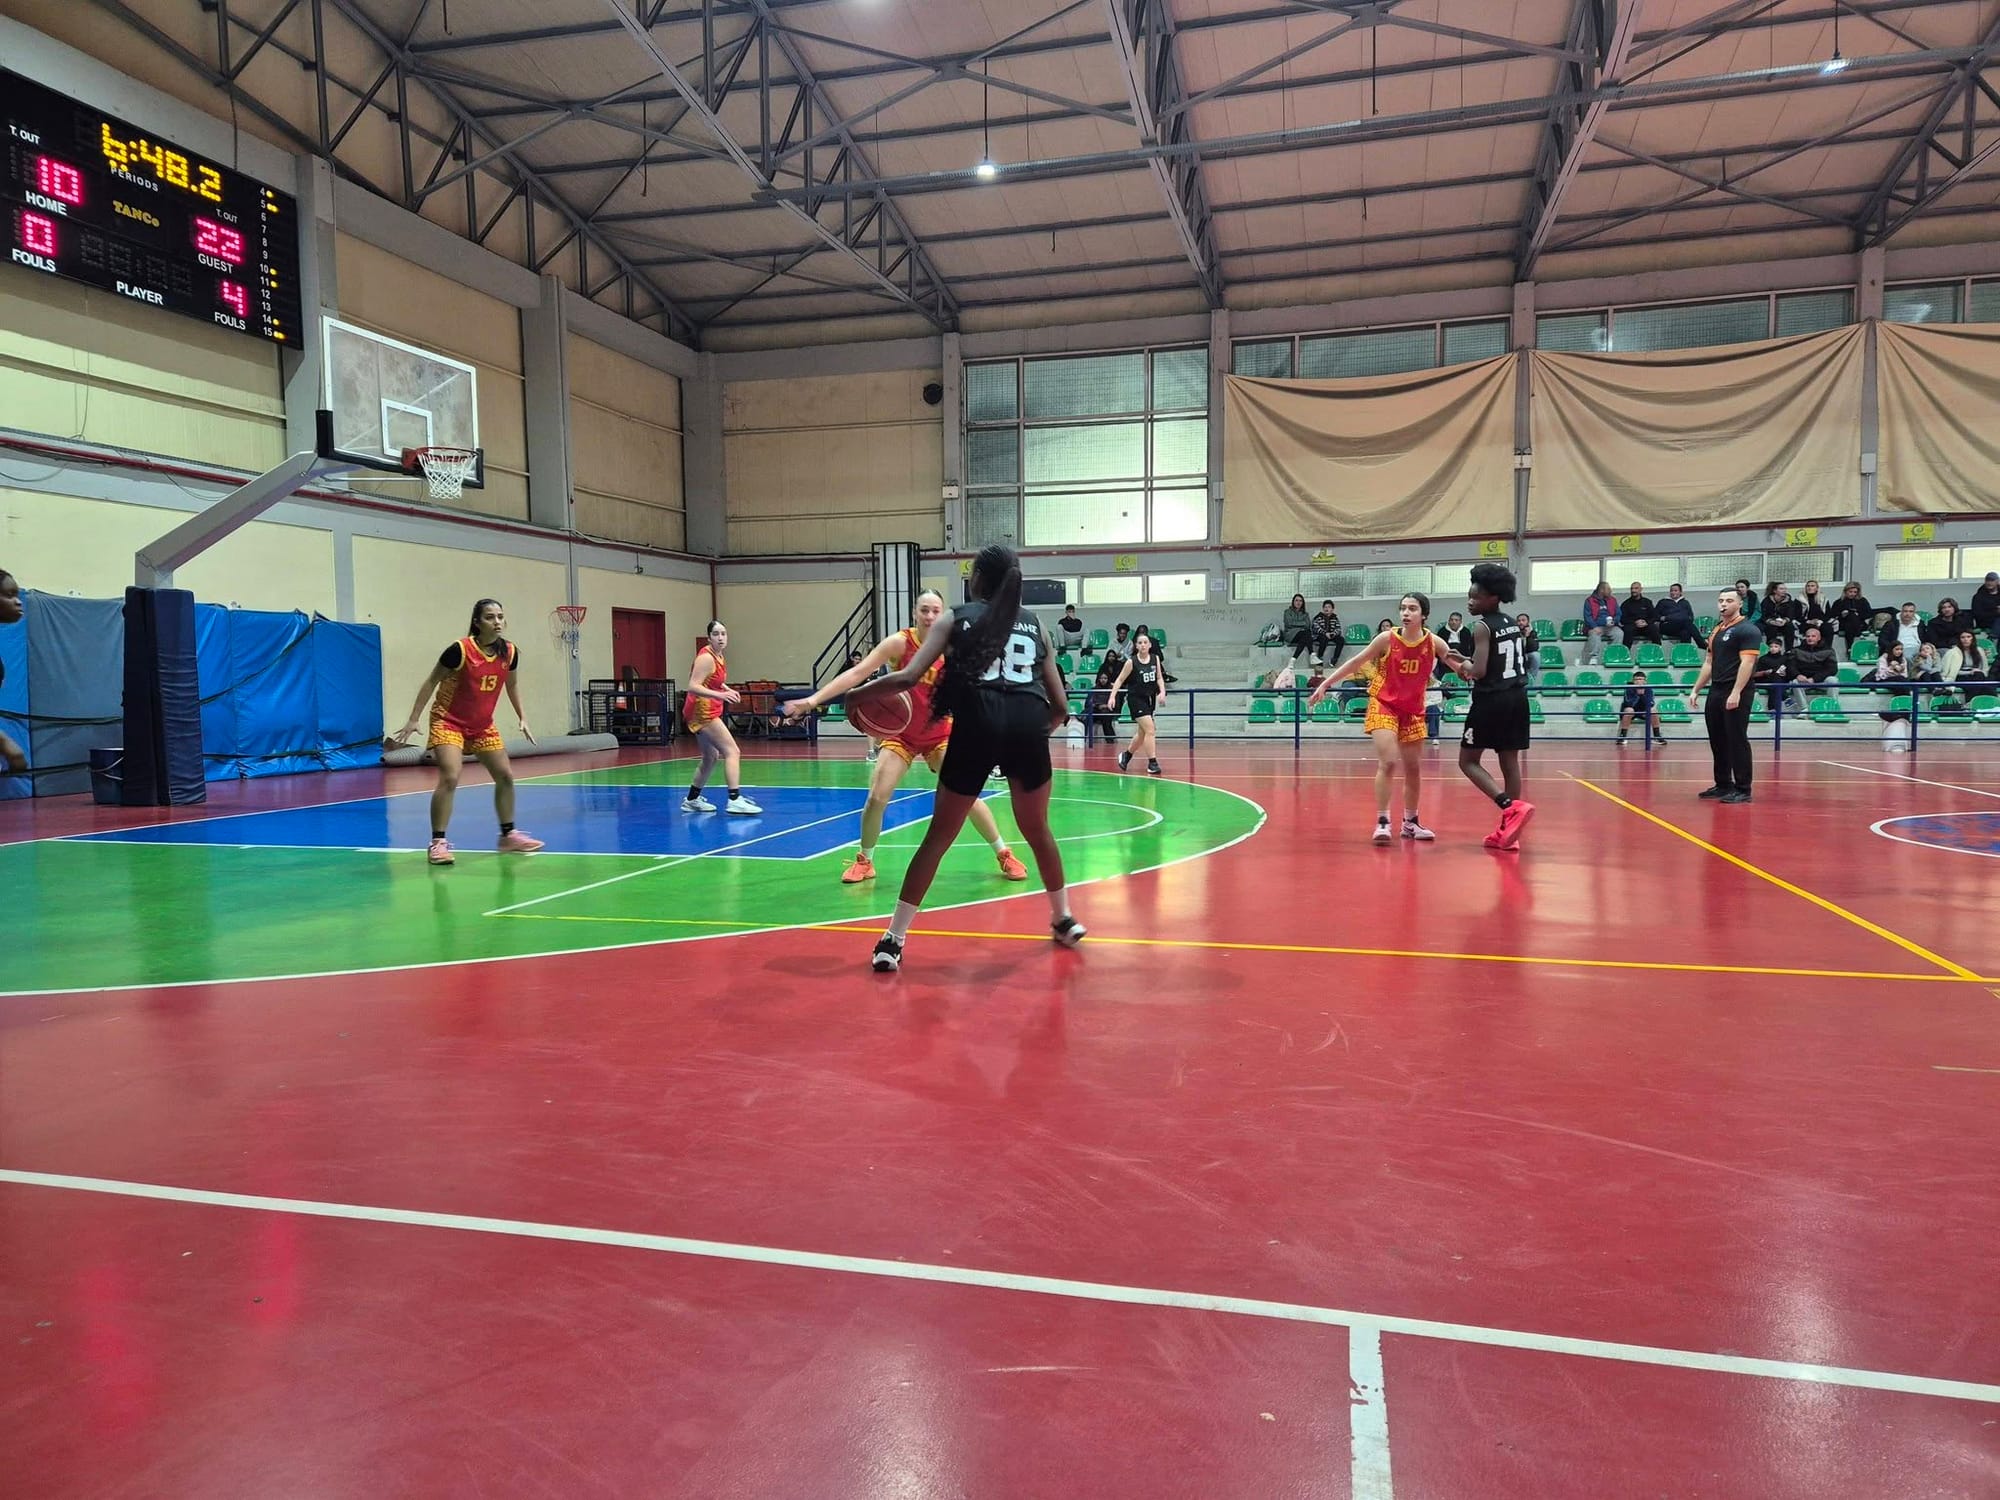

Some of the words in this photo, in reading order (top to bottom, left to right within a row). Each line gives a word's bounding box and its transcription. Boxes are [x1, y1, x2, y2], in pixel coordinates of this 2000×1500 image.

[9, 125, 18, 138] T.
[19, 129, 41, 145] OUT
[40, 158, 80, 204] 10
[110, 166, 159, 192] PERIODS
[259, 187, 265, 196] 4
[25, 190, 68, 216] HOME
[260, 200, 266, 209] 5
[216, 208, 223, 218] T.
[223, 211, 239, 224] OUT
[261, 212, 267, 222] 6
[24, 213, 53, 255] 0
[261, 224, 267, 234] 7
[196, 218, 242, 263] 22
[262, 237, 268, 247] 8
[12, 248, 57, 273] FOULS
[262, 250, 268, 259] 9
[198, 253, 234, 274] GUEST
[259, 263, 269, 273] 10
[260, 276, 270, 287] 11
[116, 280, 164, 306] PLAYER
[222, 281, 244, 316] 4
[261, 289, 271, 299] 12
[262, 302, 271, 312] 13
[214, 311, 246, 330] FOULS
[262, 314, 272, 324] 14
[263, 327, 273, 337] 15
[1399, 659, 1419, 674] 30
[480, 674, 498, 691] 13
[1142, 671, 1155, 683] 69
